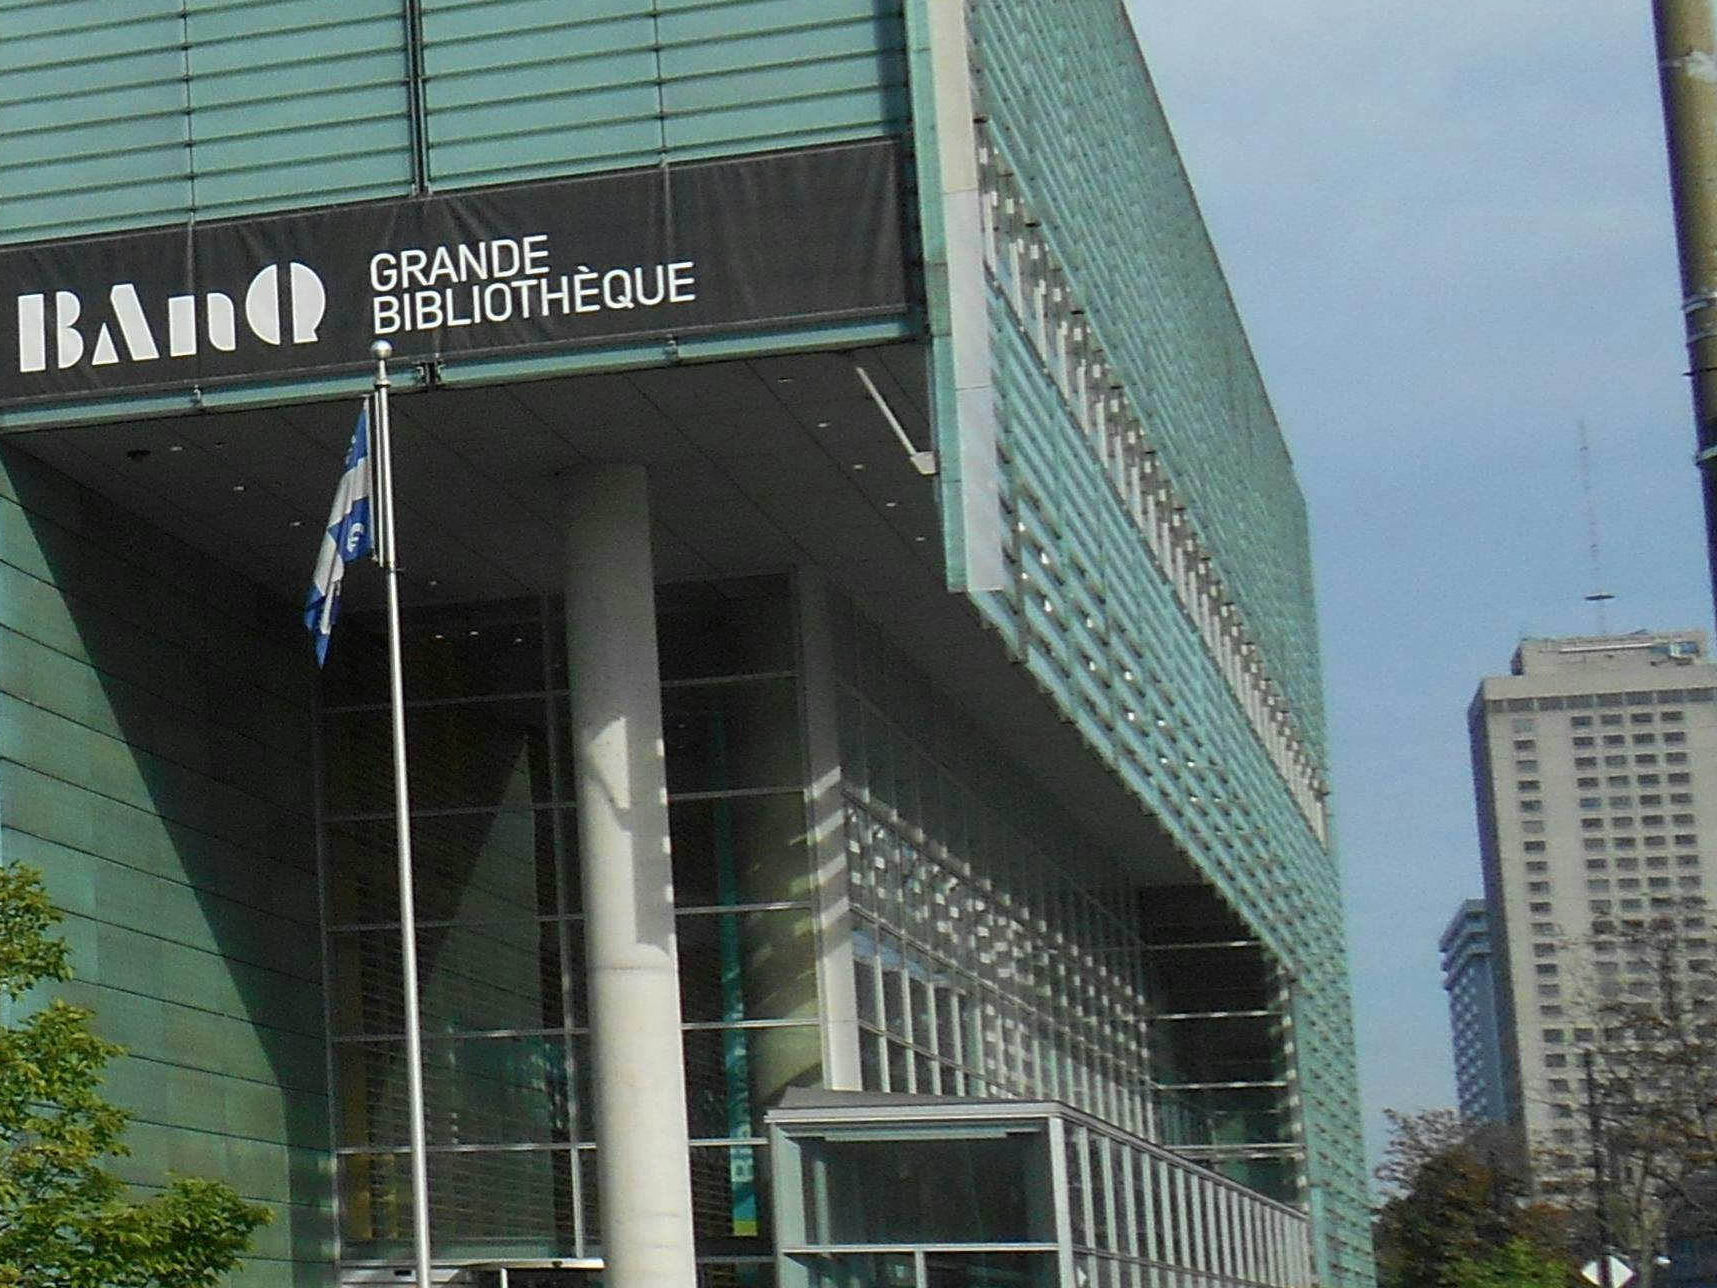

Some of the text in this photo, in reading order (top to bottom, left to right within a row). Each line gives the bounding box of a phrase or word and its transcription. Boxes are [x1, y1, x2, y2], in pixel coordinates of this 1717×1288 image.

[370, 234, 550, 292] GRANDE
[373, 261, 696, 335] BIBLIOTHÈQUE
[17, 261, 327, 373] BAnQ
